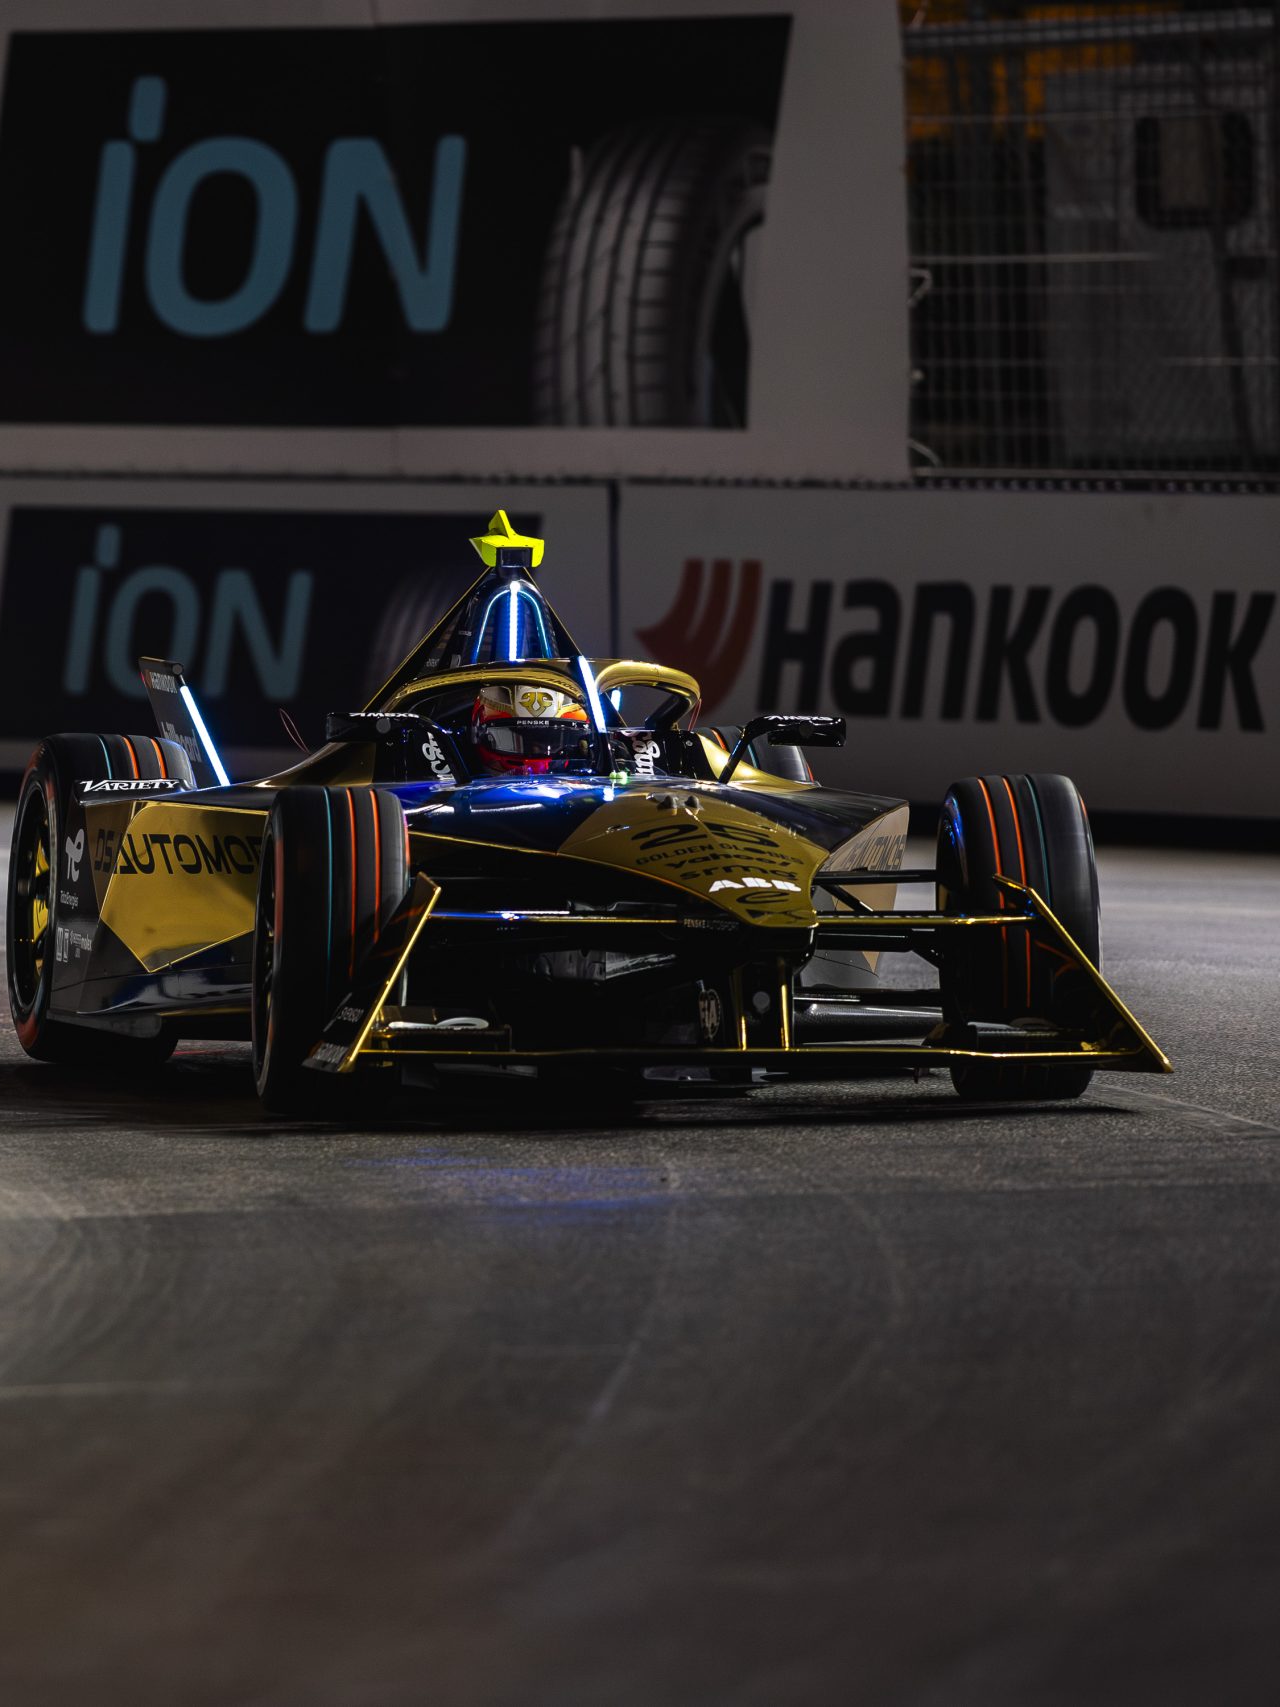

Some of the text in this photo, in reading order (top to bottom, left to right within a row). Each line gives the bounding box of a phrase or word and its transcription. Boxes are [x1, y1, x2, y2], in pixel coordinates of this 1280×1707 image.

[81, 73, 468, 339] iON
[61, 521, 315, 701] iON
[80, 780, 180, 793] VARIETY
[631, 822, 780, 850] 25
[635, 844, 715, 865] GOLDEN
[708, 877, 802, 892] ABB
